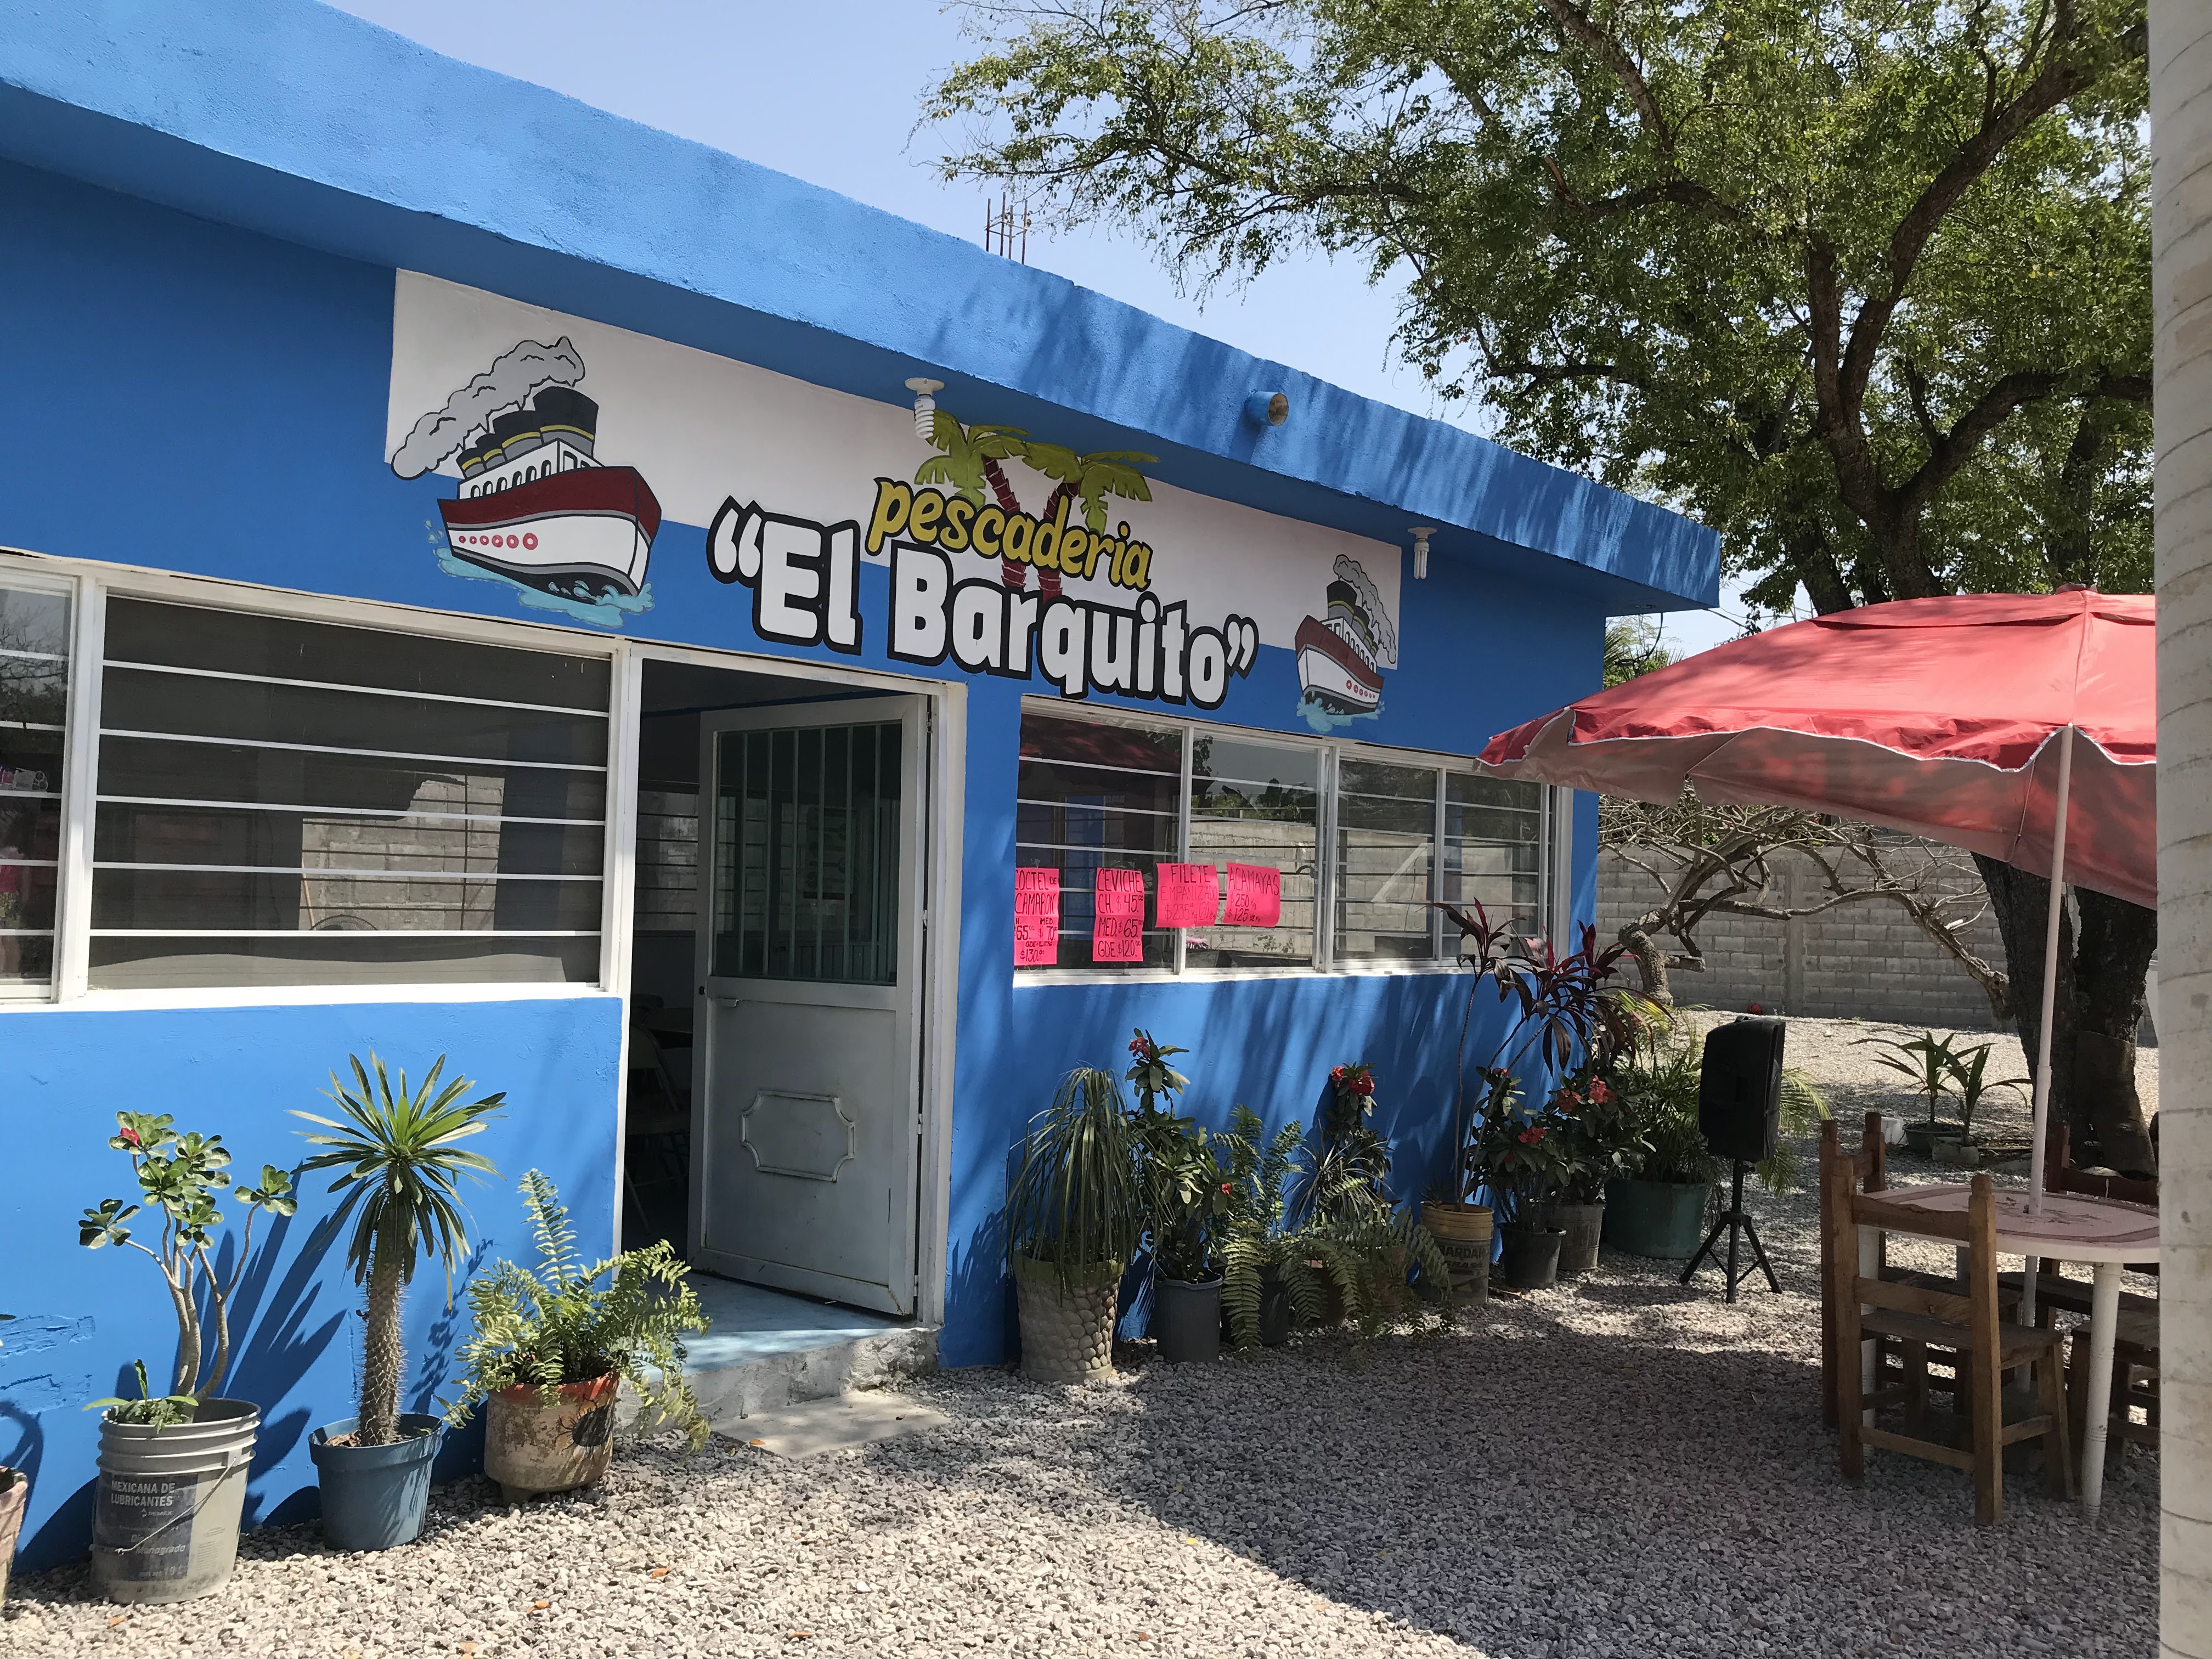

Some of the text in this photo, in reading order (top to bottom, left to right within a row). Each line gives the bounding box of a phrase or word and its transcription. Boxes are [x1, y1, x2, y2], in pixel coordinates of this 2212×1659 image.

[1049, 876, 1057, 884] DE
[1097, 868, 1142, 893] CEVICHE
[1171, 865, 1211, 883] FILETE
[1228, 867, 1280, 896] ACAMAYAS
[1160, 885, 1218, 901] EMPANIZADO
[1015, 893, 1056, 915] CAMARON
[1098, 894, 1114, 913] CH.
[1098, 917, 1117, 937] MED.
[1098, 940, 1119, 957] GDE.
[111, 1480, 176, 1494] MEXICANA DE
[111, 1493, 173, 1507] LUBRICANTES
